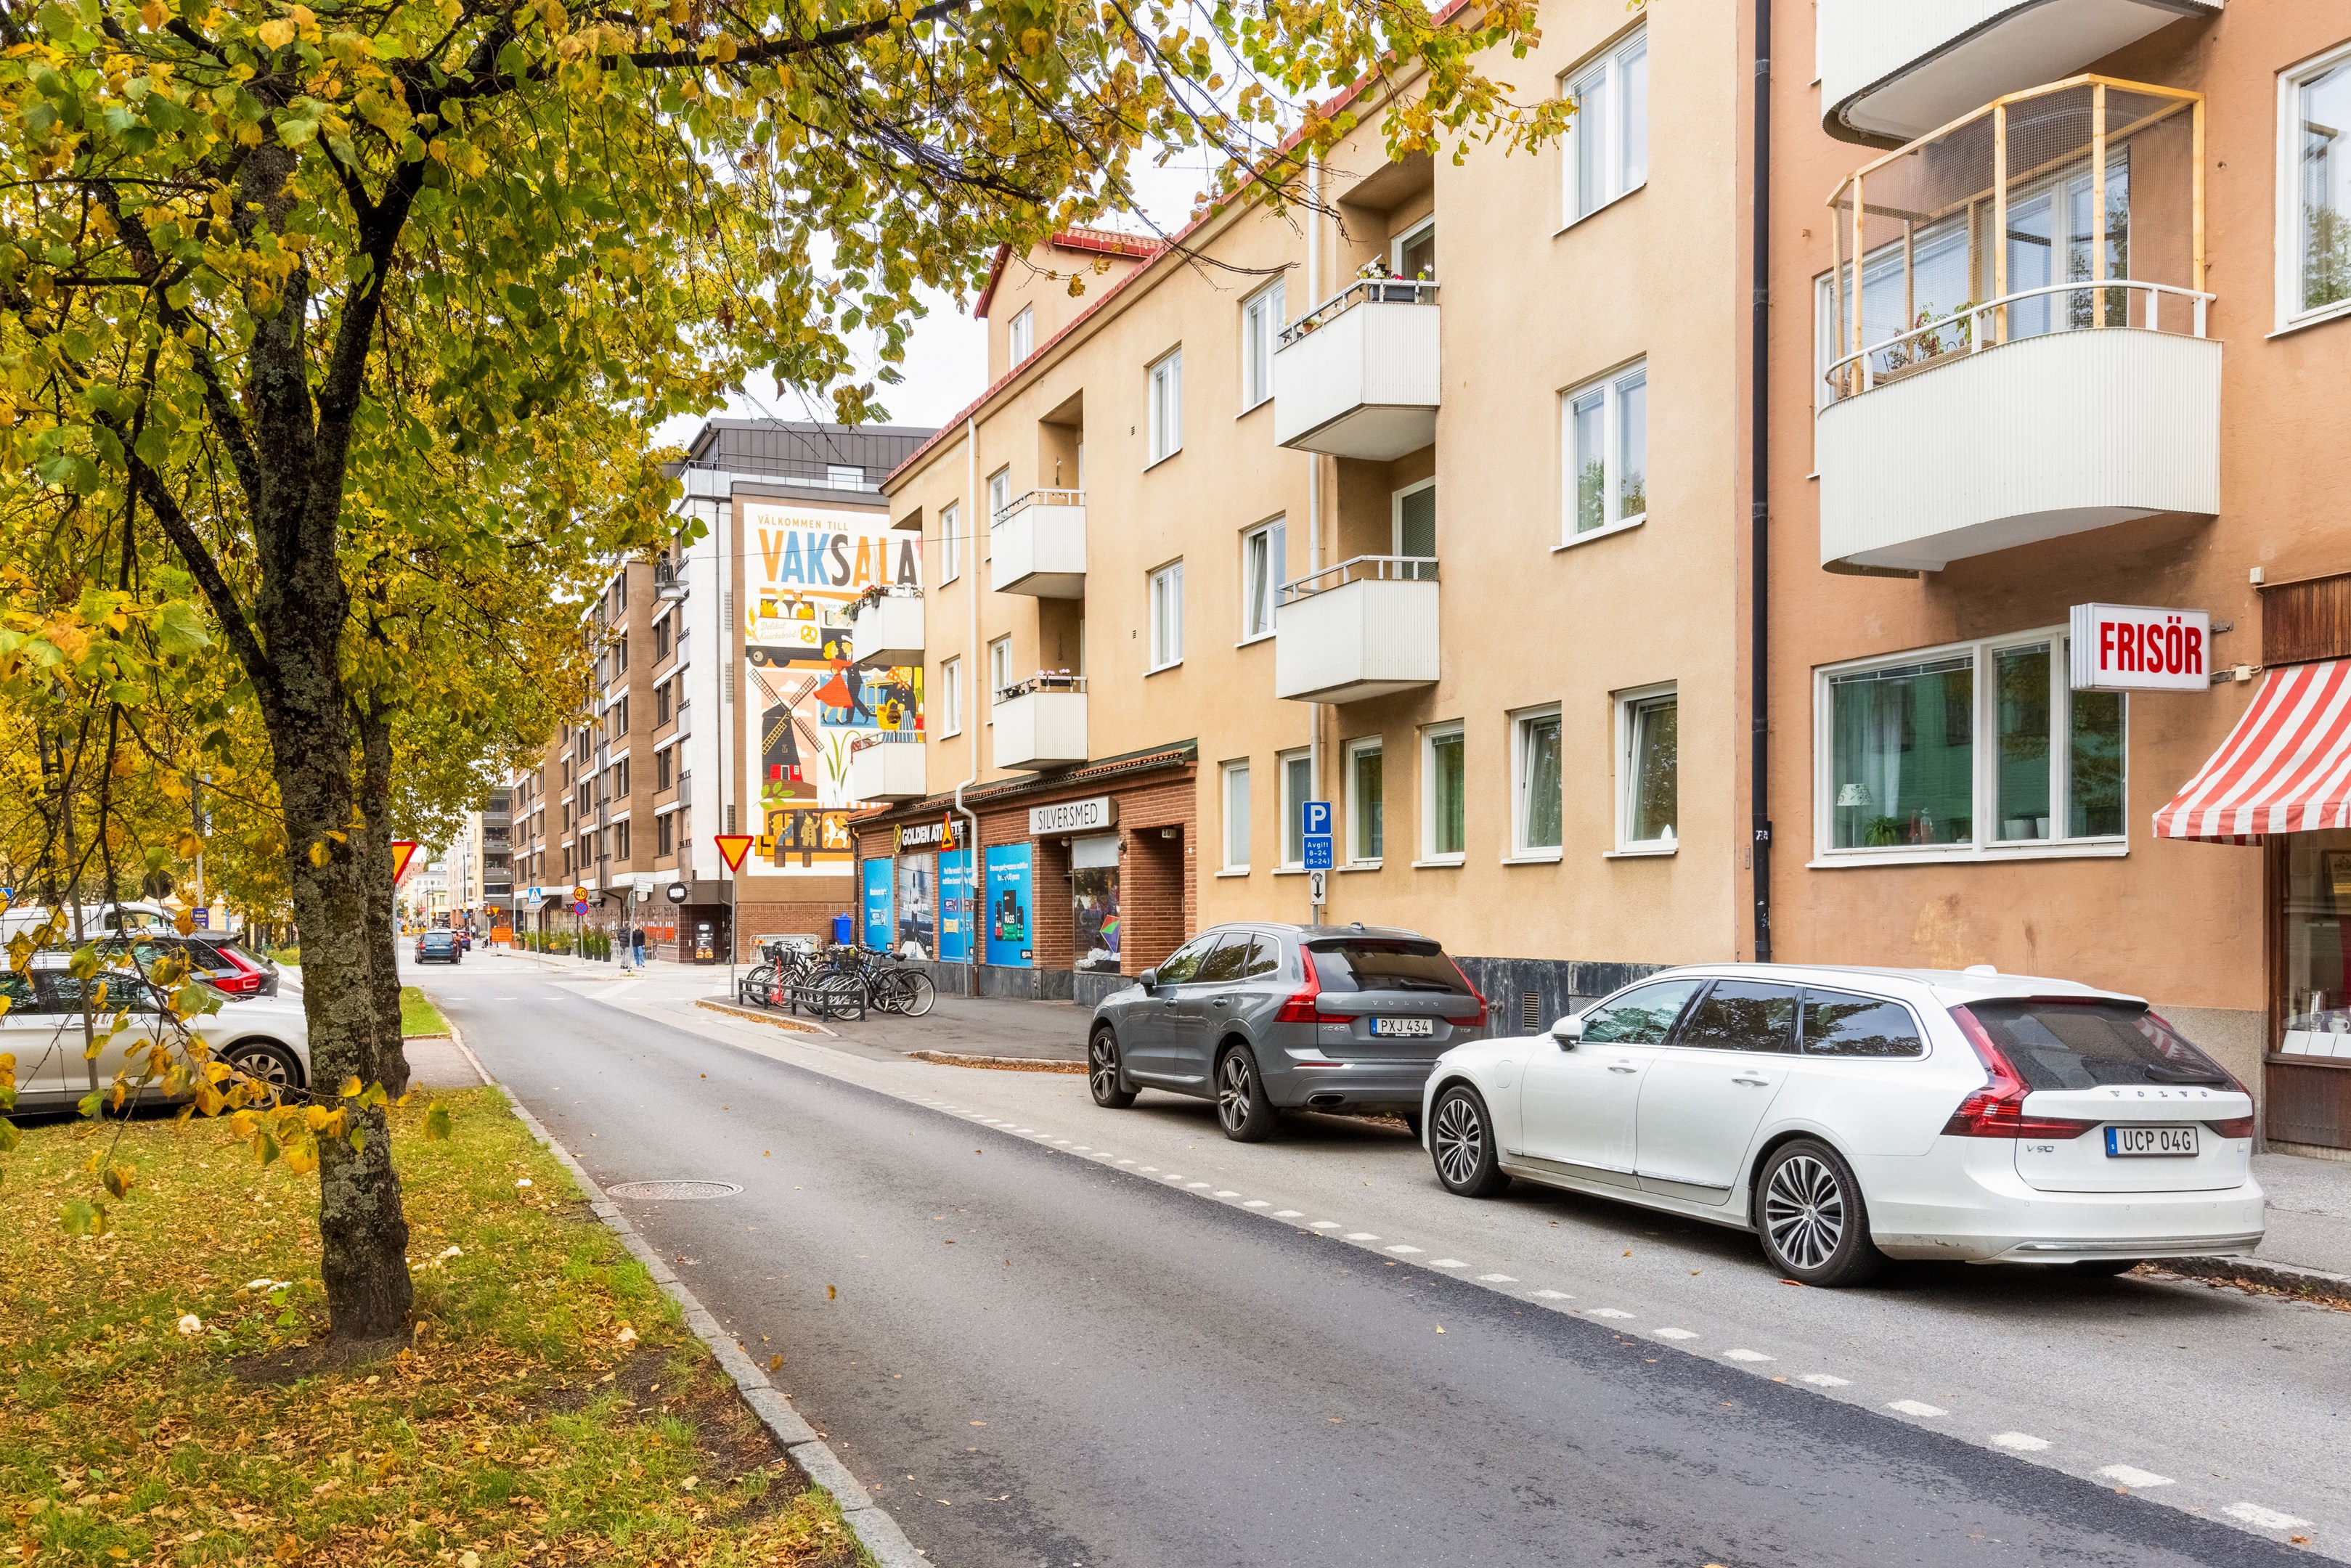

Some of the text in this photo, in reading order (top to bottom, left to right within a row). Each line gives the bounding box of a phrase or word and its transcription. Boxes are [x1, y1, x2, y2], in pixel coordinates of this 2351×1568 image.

[757, 513, 849, 531] VÄLKOMMEN TILL
[757, 528, 917, 587] VAKSALA
[2100, 616, 2202, 674] FRISÖR
[1038, 803, 1098, 830] SILVERSMED
[1310, 804, 1327, 832] P
[902, 820, 963, 846] GOLDEN ATHETE
[1381, 1020, 1428, 1032] PXJ 434
[2123, 1130, 2191, 1151] UCP 04G
